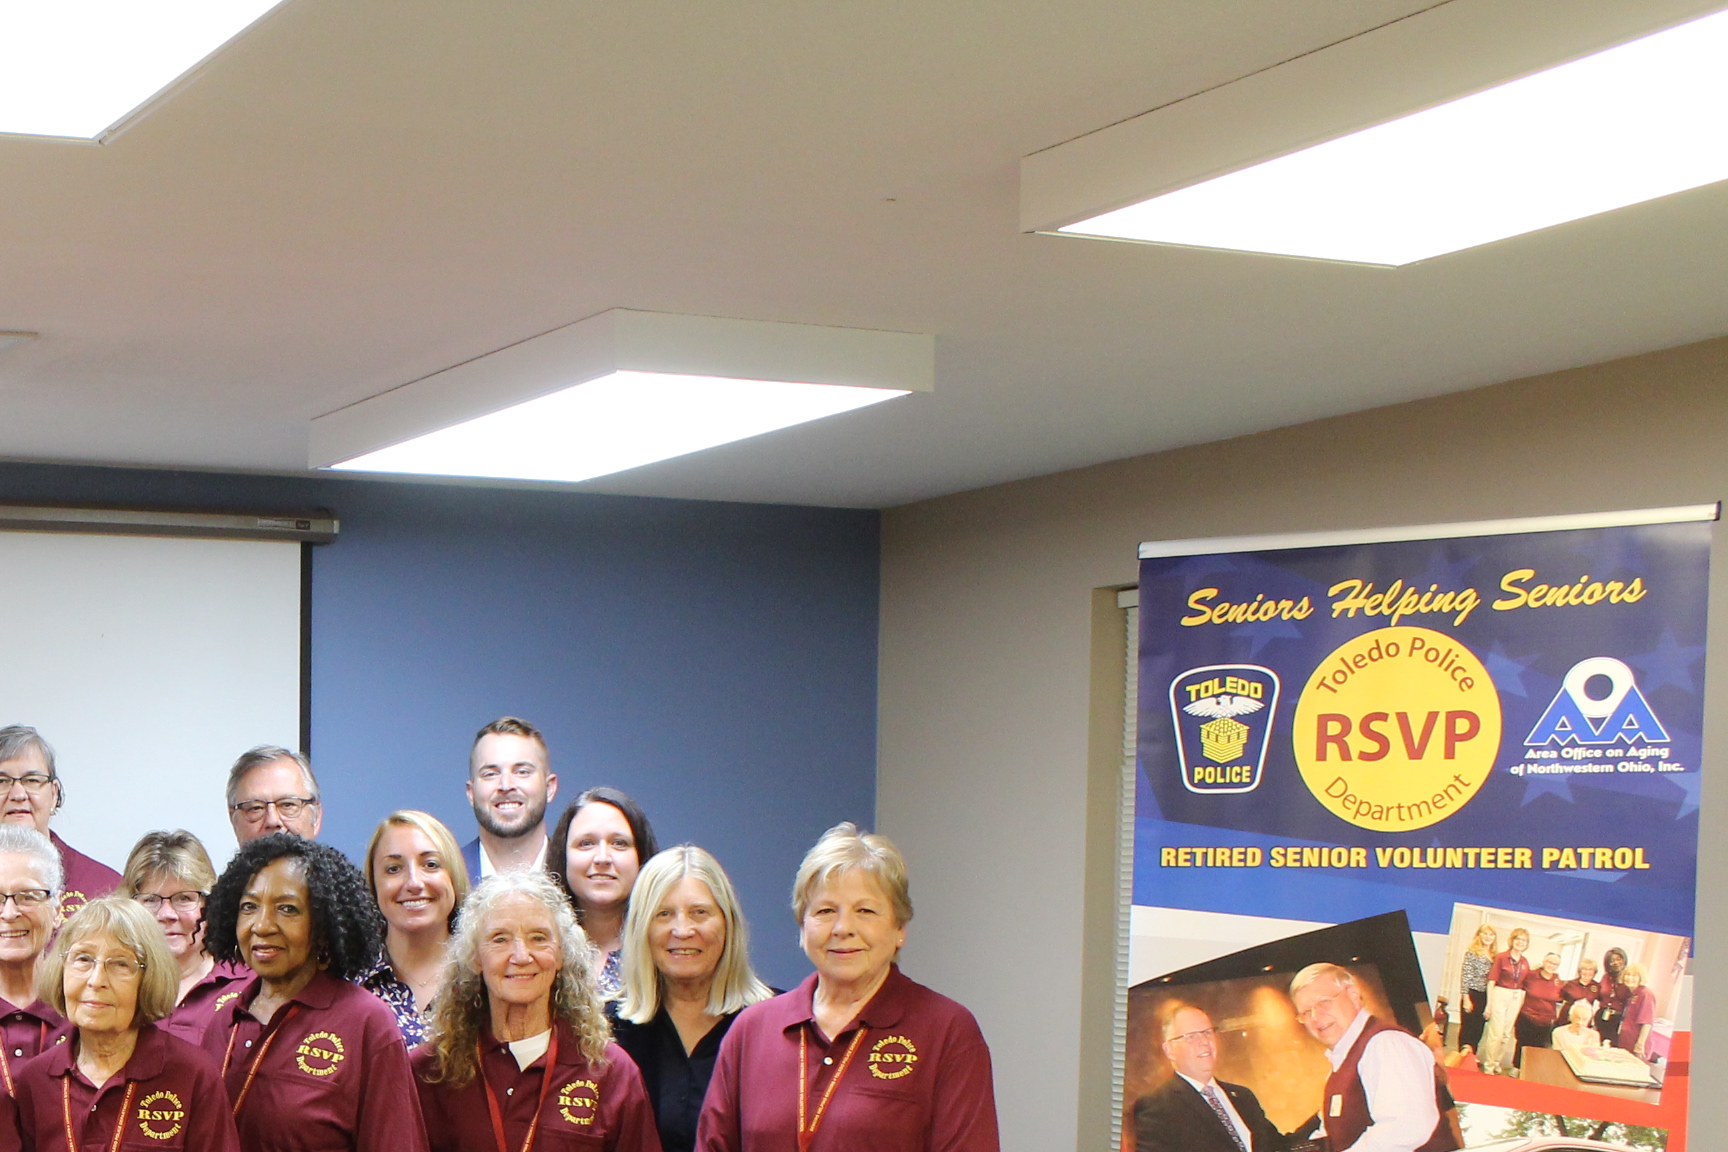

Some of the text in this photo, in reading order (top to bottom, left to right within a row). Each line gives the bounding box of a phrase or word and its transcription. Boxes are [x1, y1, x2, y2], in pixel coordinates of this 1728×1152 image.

[1180, 568, 1648, 627] Seniors Helping Seniors
[1316, 636, 1475, 695] Toledo Police
[1186, 676, 1264, 702] TOLEDO
[1315, 709, 1481, 762] RSVP
[1524, 745, 1670, 761] Area Office on Aging
[1193, 765, 1252, 784] POLICE
[1509, 760, 1685, 777] of Northwestern Ohio, Inc.
[1324, 773, 1471, 822] Department
[1159, 846, 1651, 870] RETIRED SENIOR VOLUNTEER PATROL
[303, 1030, 345, 1053] Toledo Police
[295, 1044, 345, 1063] RSVP
[867, 1052, 918, 1064] RSVP
[296, 1055, 338, 1077] Department
[139, 1090, 183, 1110] Toledo Police
[137, 1108, 185, 1121] RSVP
[138, 1120, 182, 1140] Department
